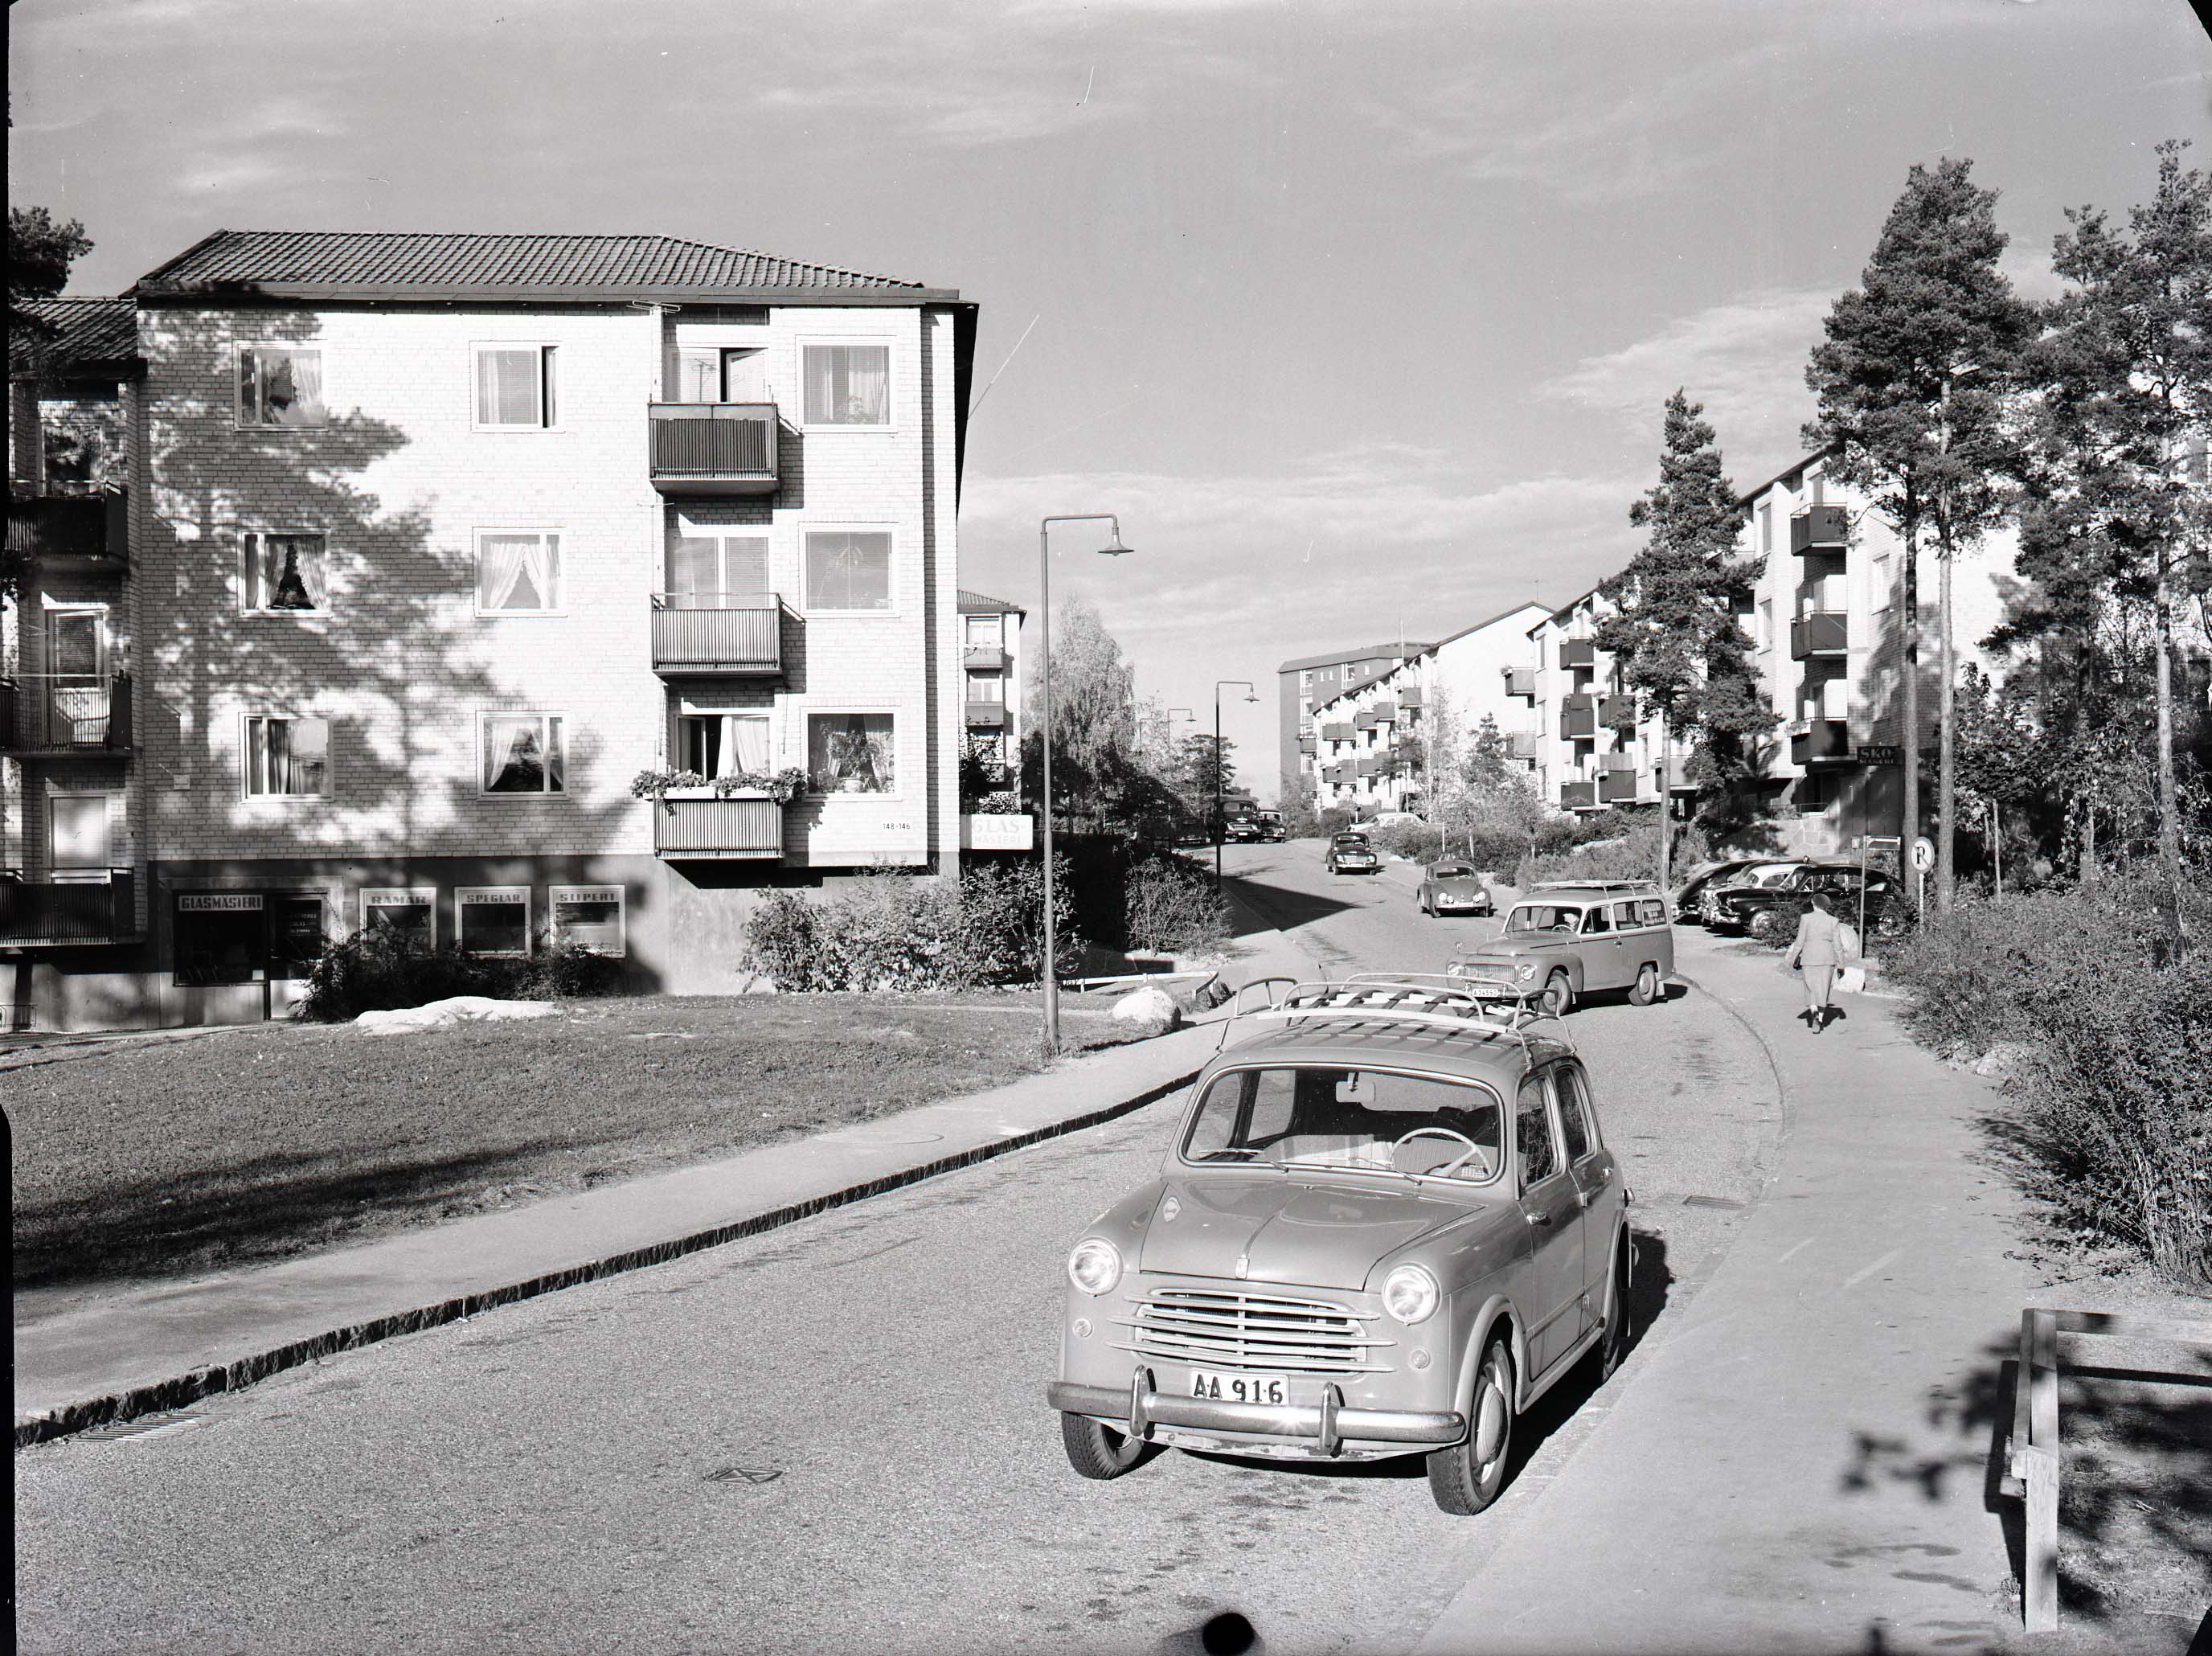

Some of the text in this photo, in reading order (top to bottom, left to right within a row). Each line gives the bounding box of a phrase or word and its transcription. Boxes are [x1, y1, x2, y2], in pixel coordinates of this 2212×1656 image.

[883, 822, 911, 830] 148-146
[1916, 846, 1925, 864] P
[466, 894, 521, 903] SPEGLAR
[1194, 1374, 1284, 1404] AA 916
